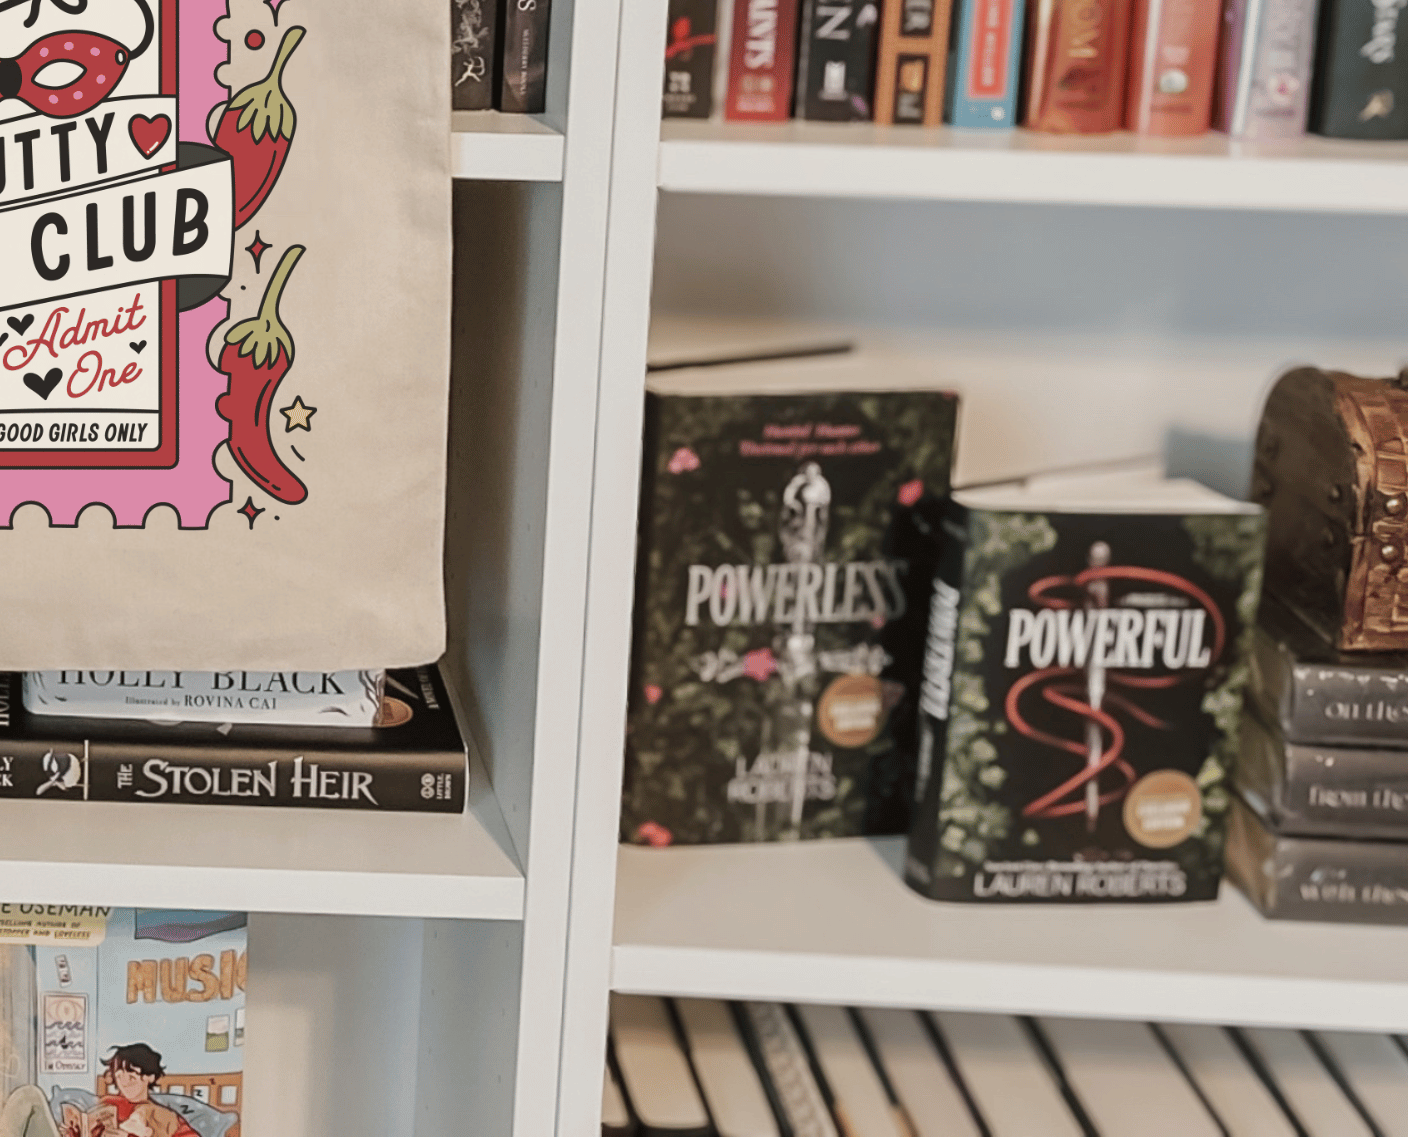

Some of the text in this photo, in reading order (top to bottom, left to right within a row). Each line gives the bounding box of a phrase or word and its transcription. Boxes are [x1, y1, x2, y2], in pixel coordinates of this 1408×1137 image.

[30, 187, 211, 282] CLUB
[2, 292, 148, 372] Admit
[65, 349, 144, 400] One
[48, 422, 101, 445] GIRLS
[103, 421, 149, 444] ONLY
[684, 560, 910, 628] POWERLESS
[1003, 607, 1211, 670] POWERFUL
[183, 694, 244, 710] ROVINA
[248, 697, 278, 710] CAI
[116, 755, 380, 806] THE STOLEN HEIR
[19, 902, 112, 918] OSEMAN
[973, 871, 1072, 898] LAUREN
